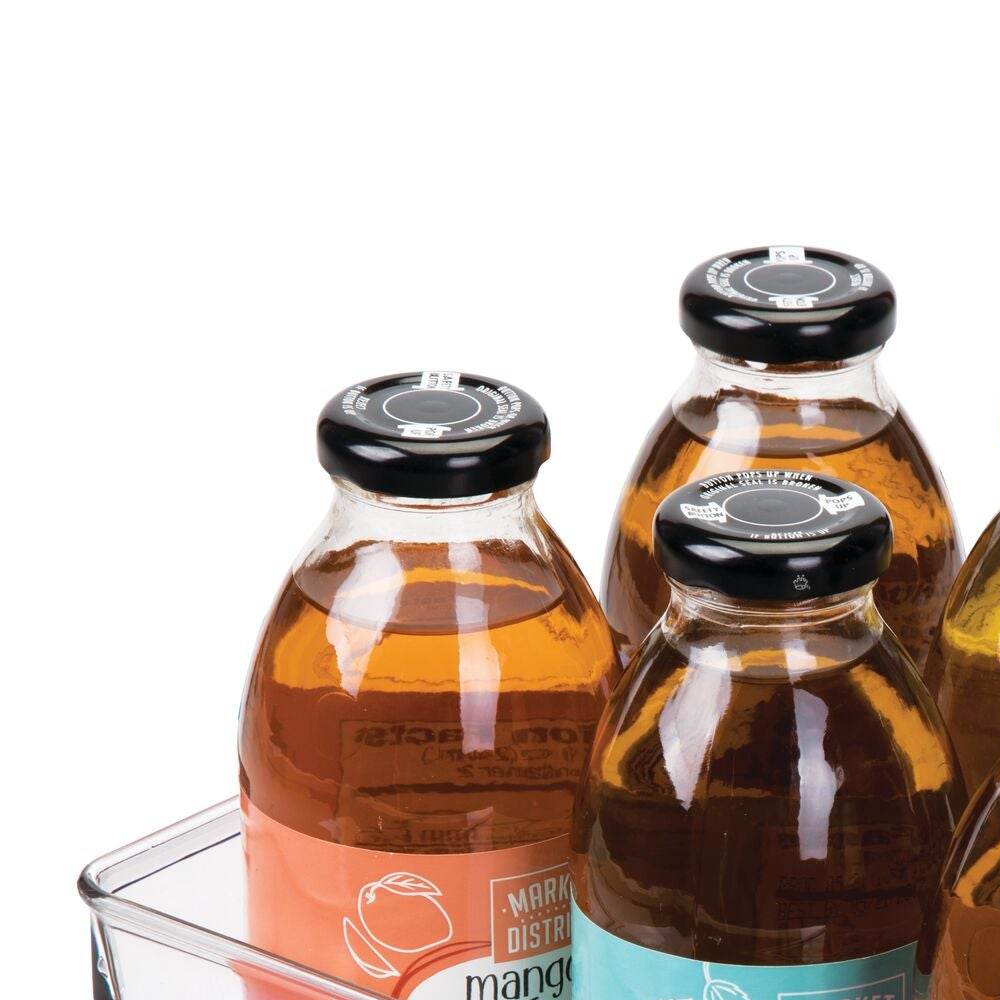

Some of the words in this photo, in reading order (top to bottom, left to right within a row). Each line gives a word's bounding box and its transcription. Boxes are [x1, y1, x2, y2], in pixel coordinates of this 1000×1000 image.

[699, 474, 734, 489] BUTTON
[736, 470, 762, 480] POPS
[766, 470, 780, 478] UP
[784, 471, 814, 482] WHEN
[738, 479, 764, 487] SEAL
[781, 480, 823, 492] BROKEN
[507, 872, 571, 919] MARK
[507, 910, 571, 955] DISTRI
